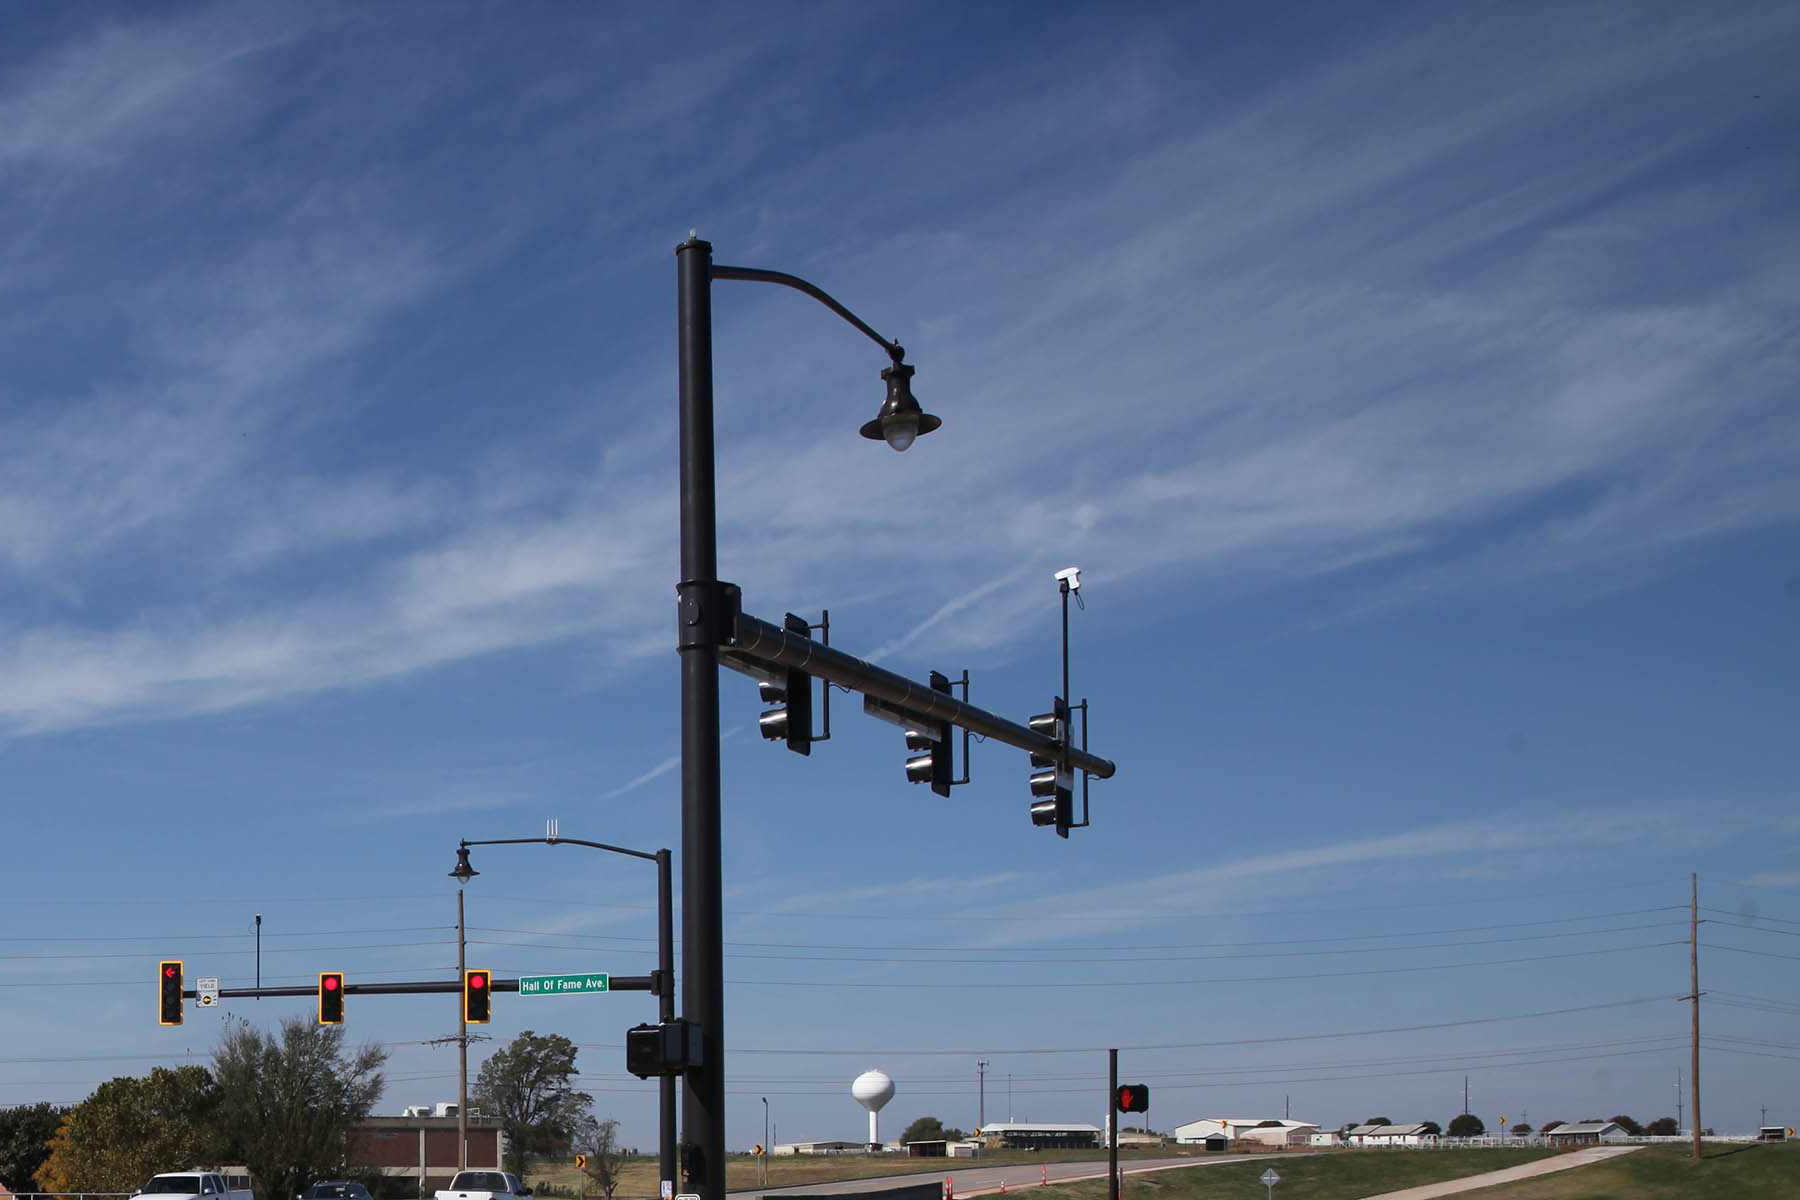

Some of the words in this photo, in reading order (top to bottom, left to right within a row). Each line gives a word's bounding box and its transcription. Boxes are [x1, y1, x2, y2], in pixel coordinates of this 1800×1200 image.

[522, 981, 540, 991] Hall
[543, 979, 554, 990] Of
[557, 979, 582, 990] Fame
[585, 978, 605, 988] Ave.
